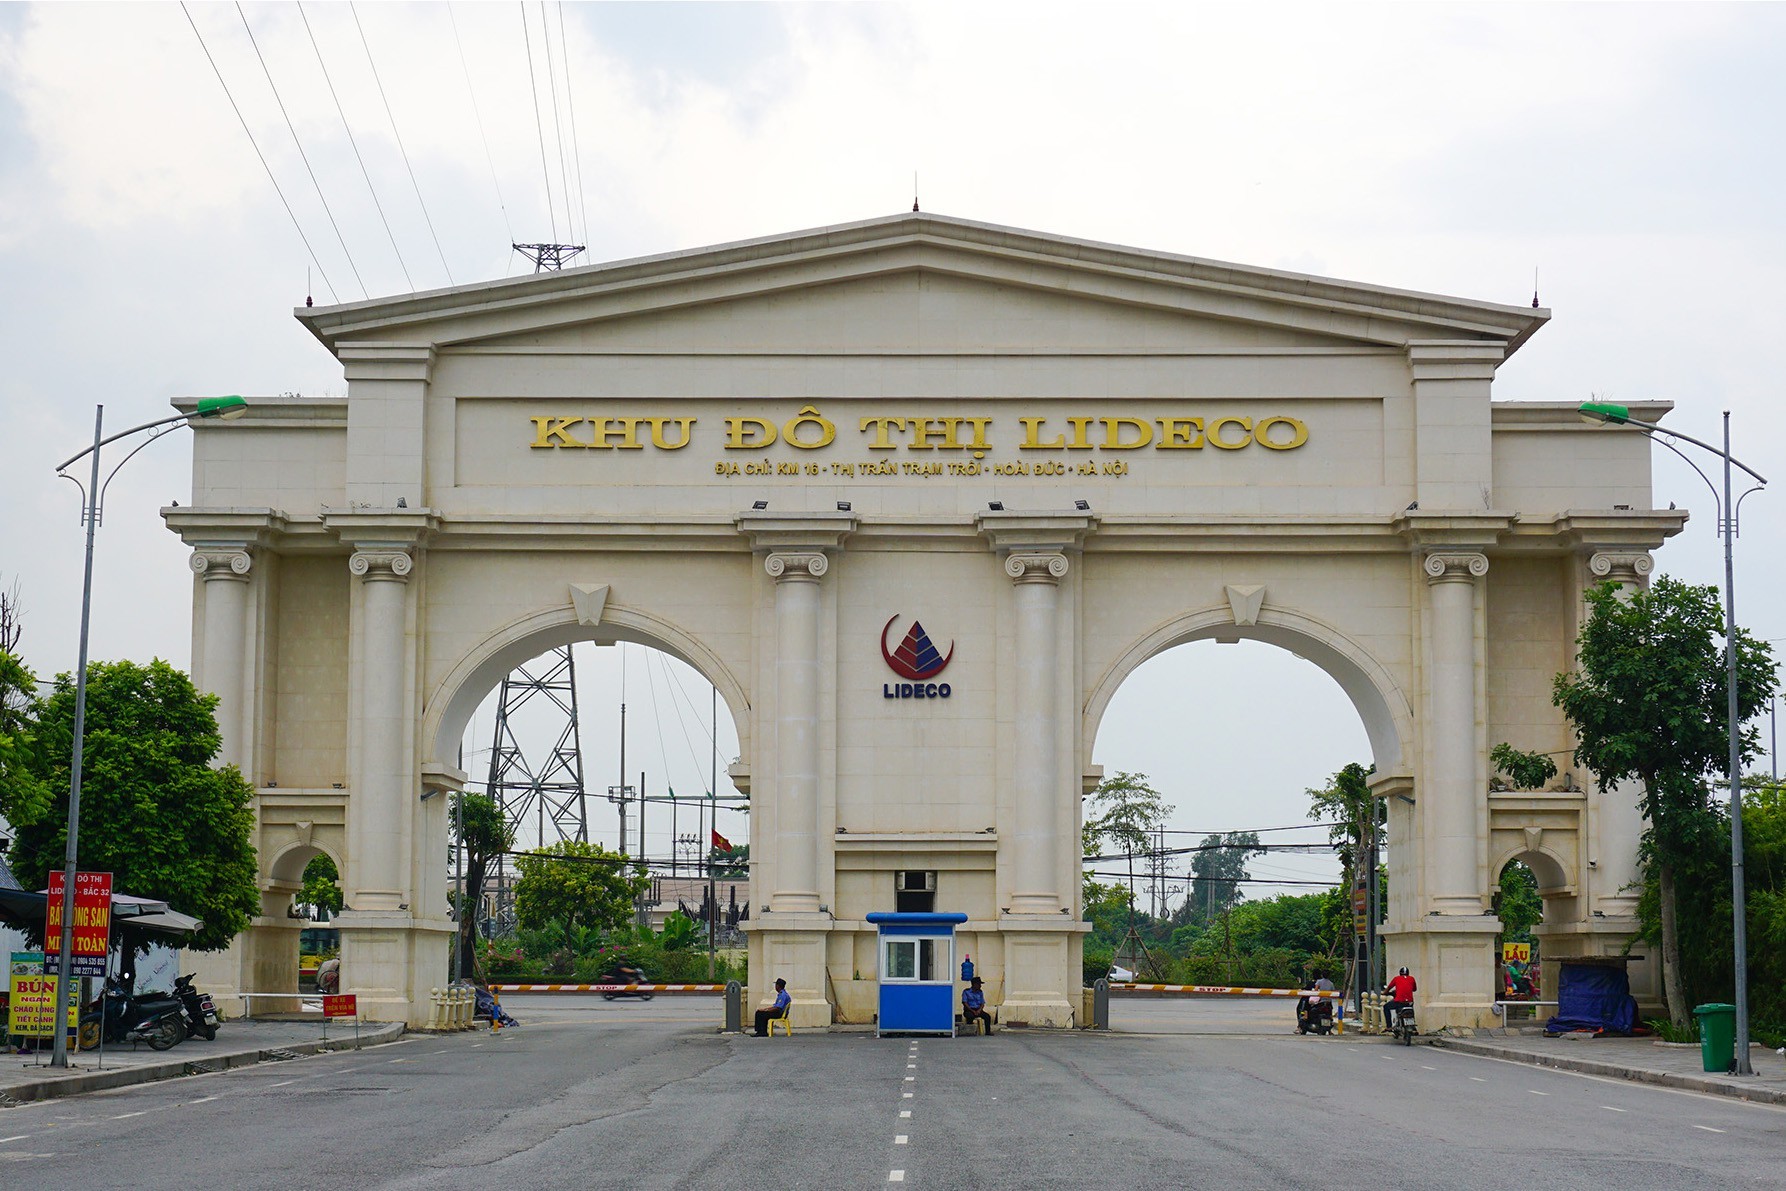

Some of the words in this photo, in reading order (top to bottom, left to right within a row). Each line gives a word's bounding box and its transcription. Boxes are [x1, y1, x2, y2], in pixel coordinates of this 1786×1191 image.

[530, 416, 697, 449] KHU
[724, 405, 836, 450] ĐÔ
[859, 416, 993, 459] THỊ
[1018, 415, 1310, 450] LIDECO
[714, 461, 740, 478] ĐỊA
[777, 463, 799, 475] KM
[804, 463, 818, 475] 16
[831, 462, 854, 478] THỊ
[858, 458, 898, 475] TRẤN
[902, 462, 943, 479] TRẠM
[993, 459, 1030, 475] HOÀI
[1077, 460, 1098, 475] HÀ
[1102, 459, 1129, 478] NỘI
[883, 683, 952, 699] LIDECO
[77, 933, 107, 952] TOÀN
[17, 978, 56, 993] BÚN
